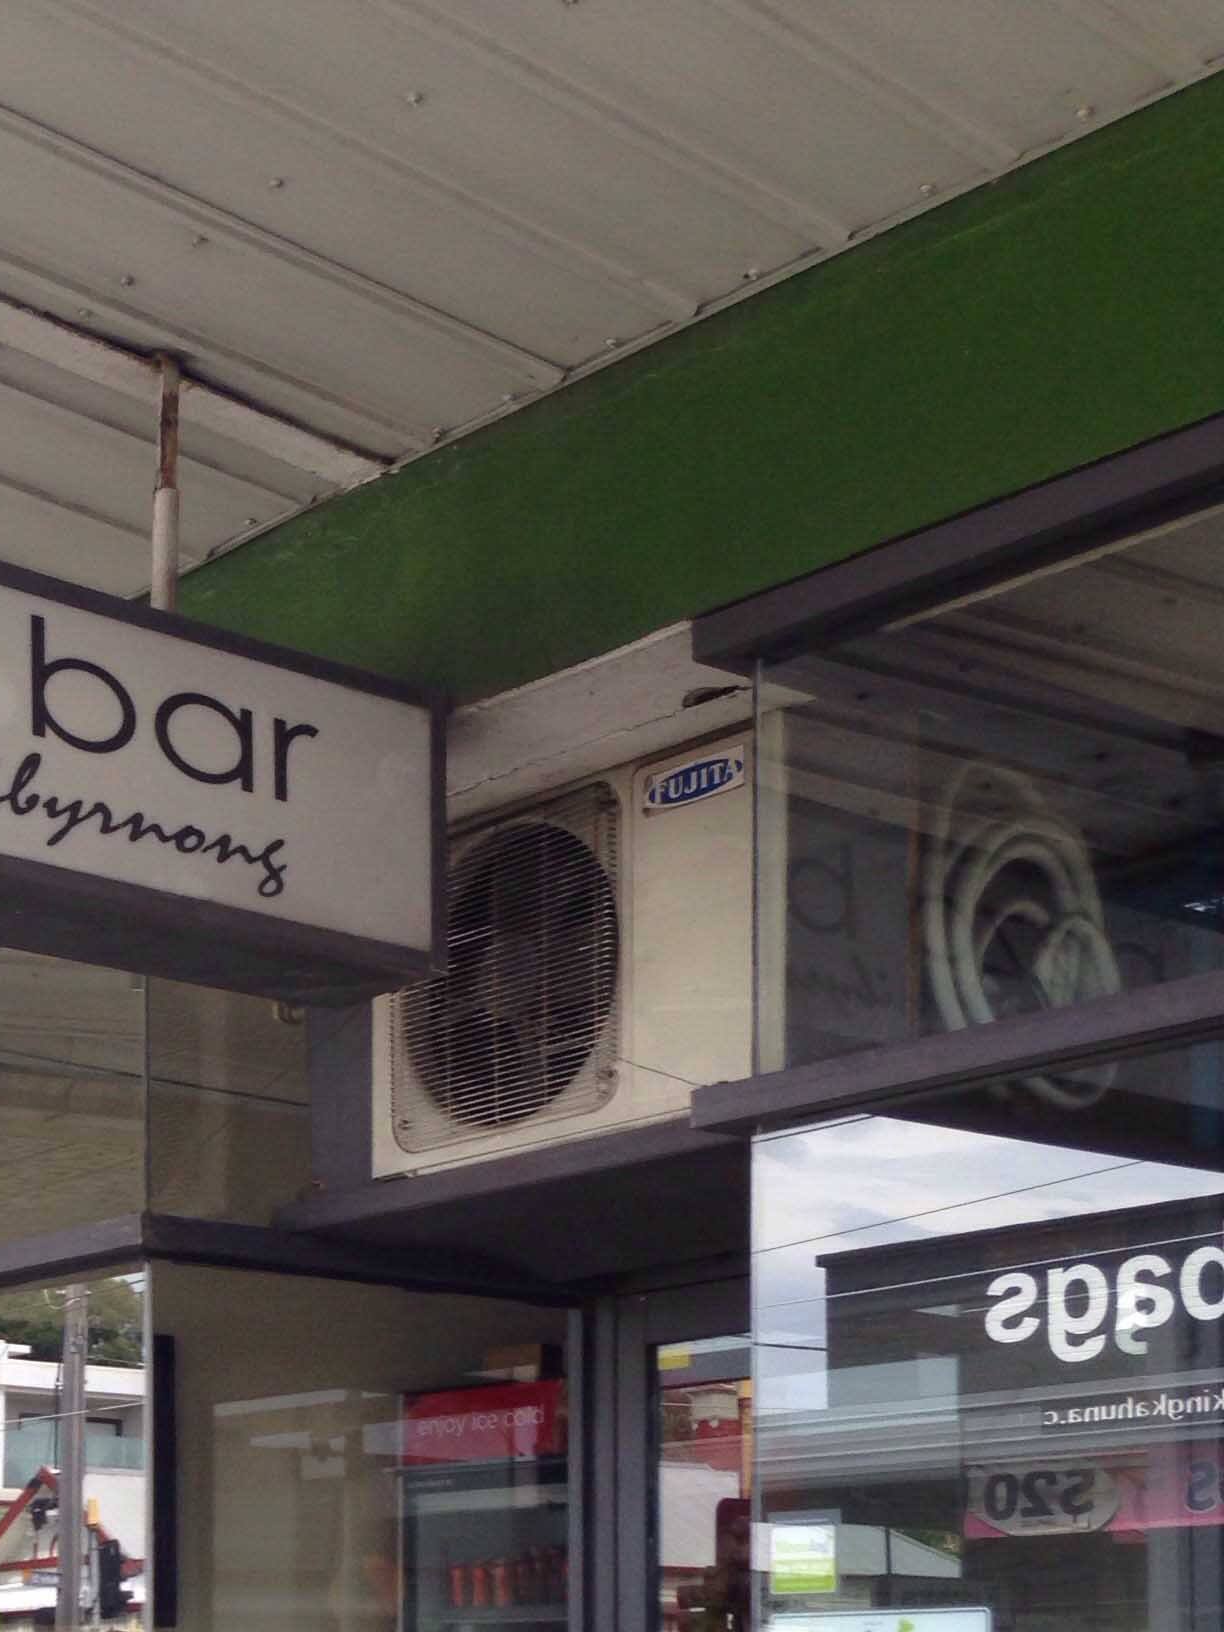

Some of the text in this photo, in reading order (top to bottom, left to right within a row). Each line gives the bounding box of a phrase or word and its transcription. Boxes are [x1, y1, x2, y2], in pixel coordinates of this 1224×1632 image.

[29, 614, 319, 801] bar
[652, 756, 738, 804] FUJITA
[417, 1403, 545, 1438] enjoy ice cold
